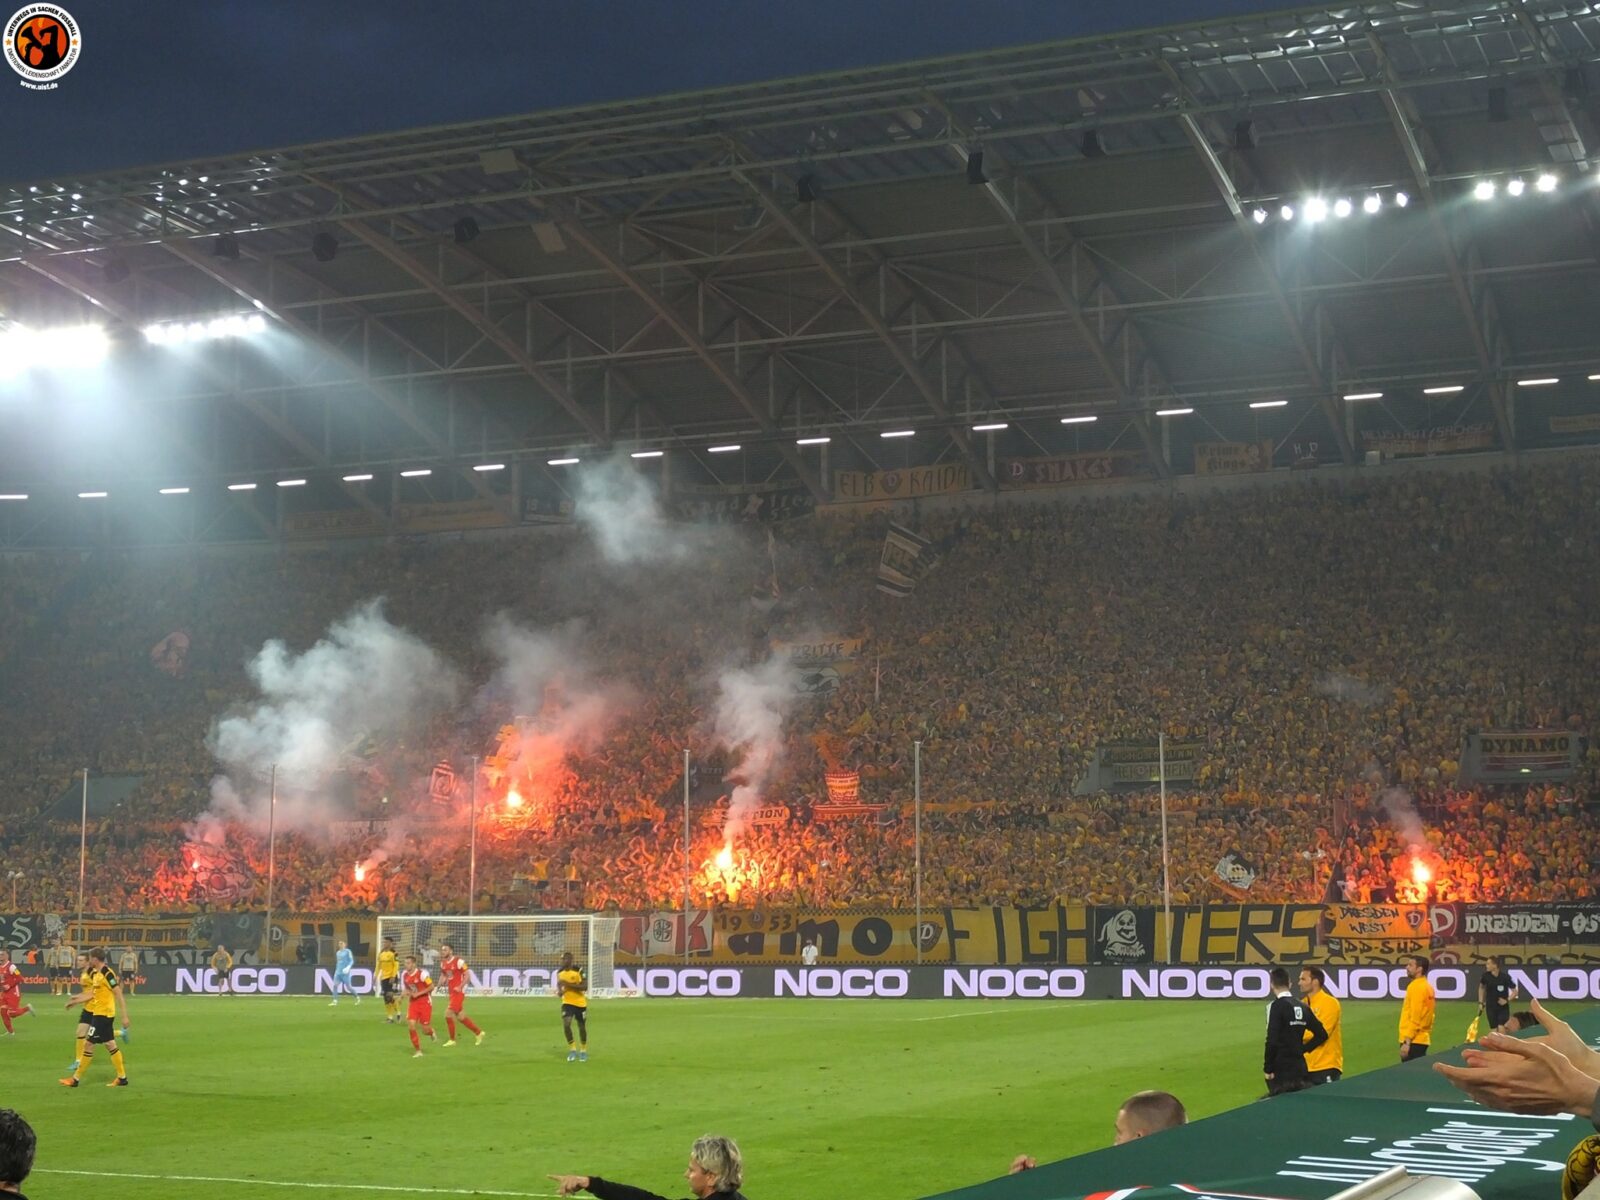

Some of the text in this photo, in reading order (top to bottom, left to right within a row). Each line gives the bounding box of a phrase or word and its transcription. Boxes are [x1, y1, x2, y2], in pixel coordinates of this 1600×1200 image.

[839, 471, 874, 497] ELB
[1480, 737, 1570, 753] DYNAMO
[719, 914, 741, 931] 19
[769, 913, 793, 931] 53
[1340, 905, 1399, 919] DRESDEN
[1465, 914, 1560, 934] DRESDEN
[175, 968, 287, 993] NOCO
[503, 986, 532, 996] Hotel?
[614, 968, 741, 996] NOCO
[774, 969, 908, 997] NOCO
[943, 969, 1085, 997] NOCO
[1122, 968, 1271, 998] NOCO
[1508, 969, 1600, 999] NO
[1276, 1120, 1567, 1183] Allgäuer
